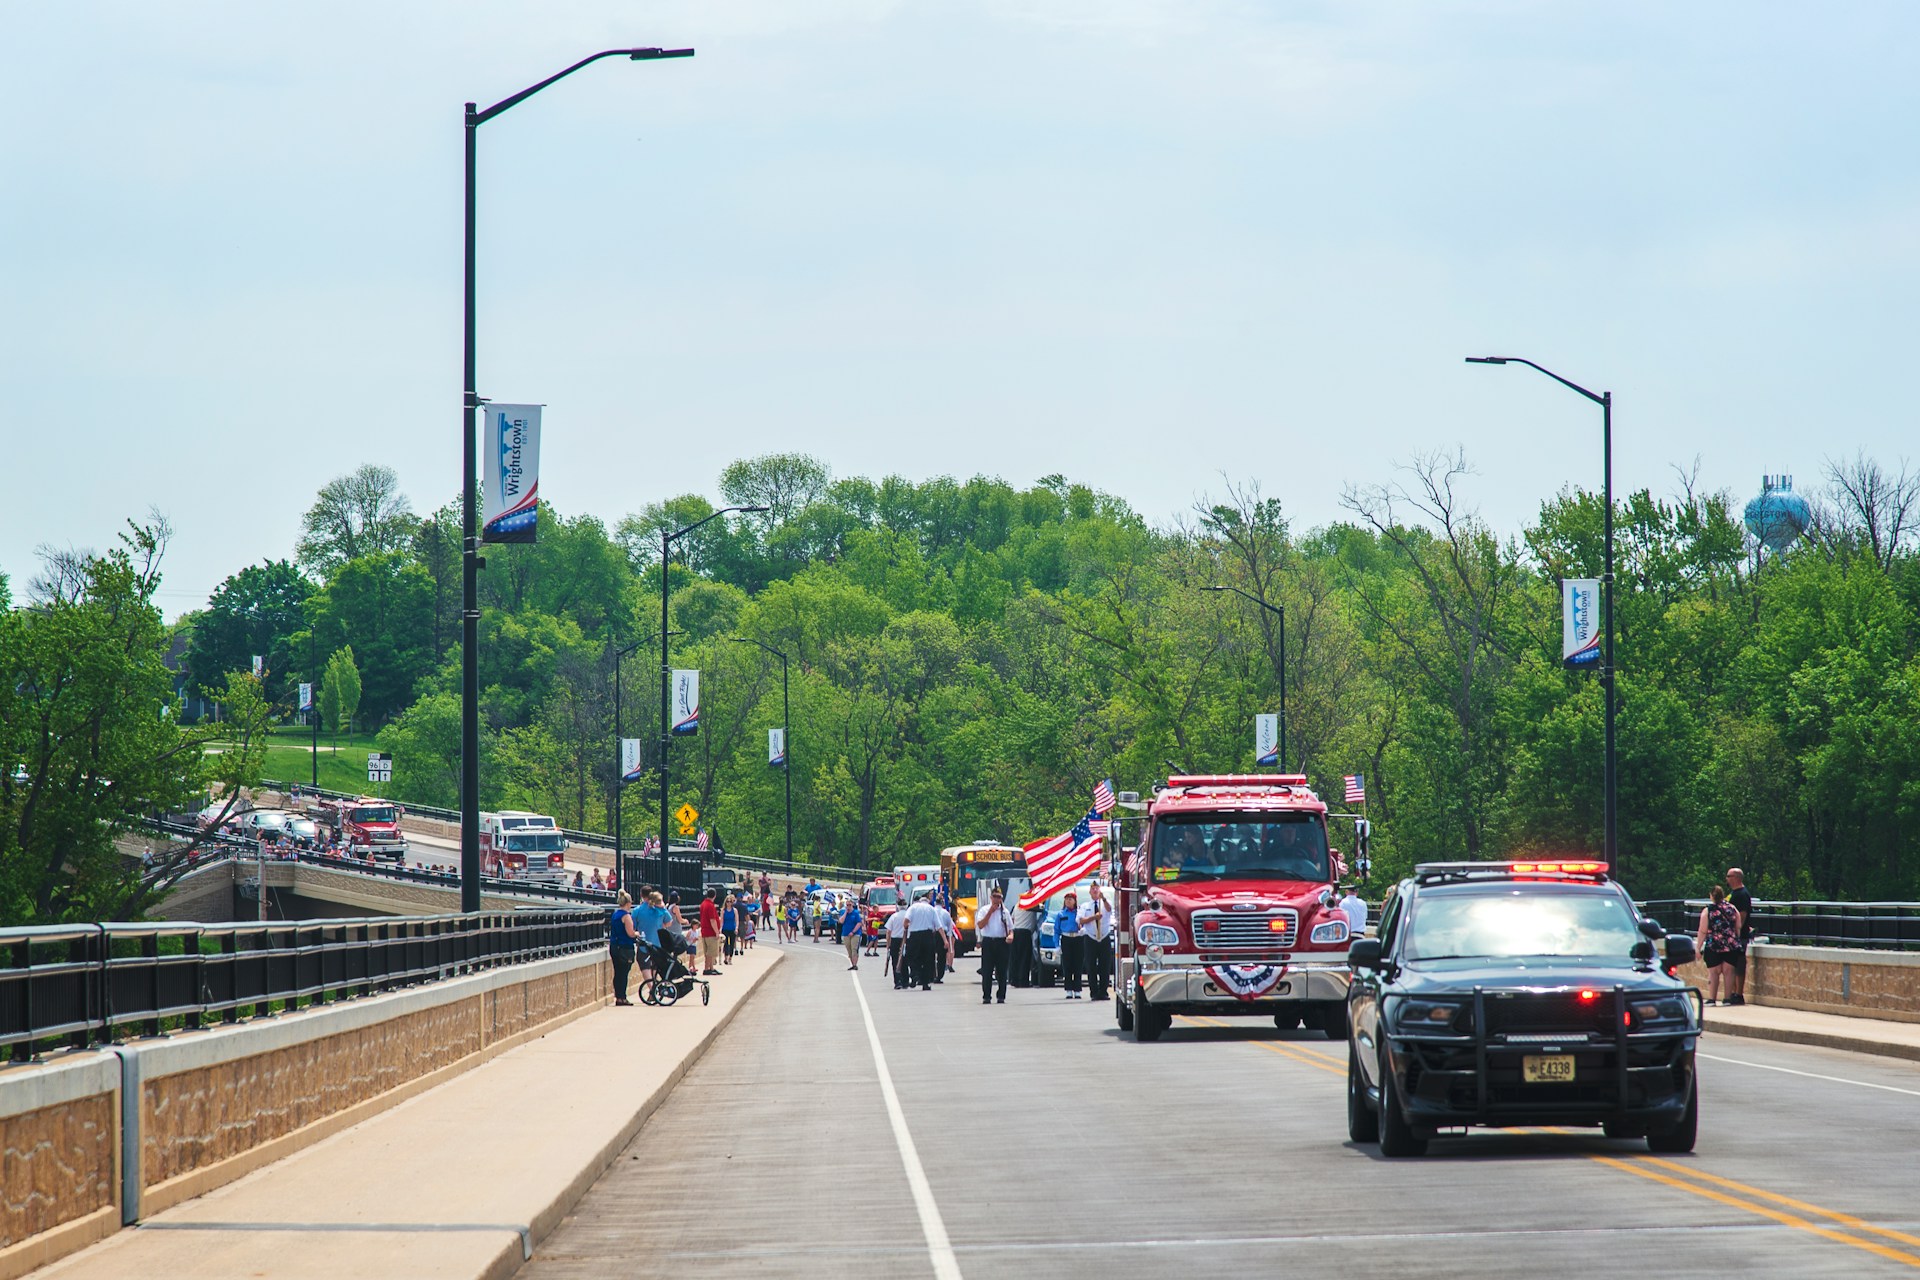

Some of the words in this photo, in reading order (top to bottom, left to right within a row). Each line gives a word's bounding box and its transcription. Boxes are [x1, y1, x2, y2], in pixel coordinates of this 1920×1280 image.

[507, 419, 523, 497] Wrightstown
[1579, 590, 1589, 641] Wrightstown
[1261, 719, 1270, 752] Welcome
[976, 852, 999, 861] SCHOOL
[1000, 852, 1012, 861] BUS
[1540, 1062, 1571, 1076] E4338
